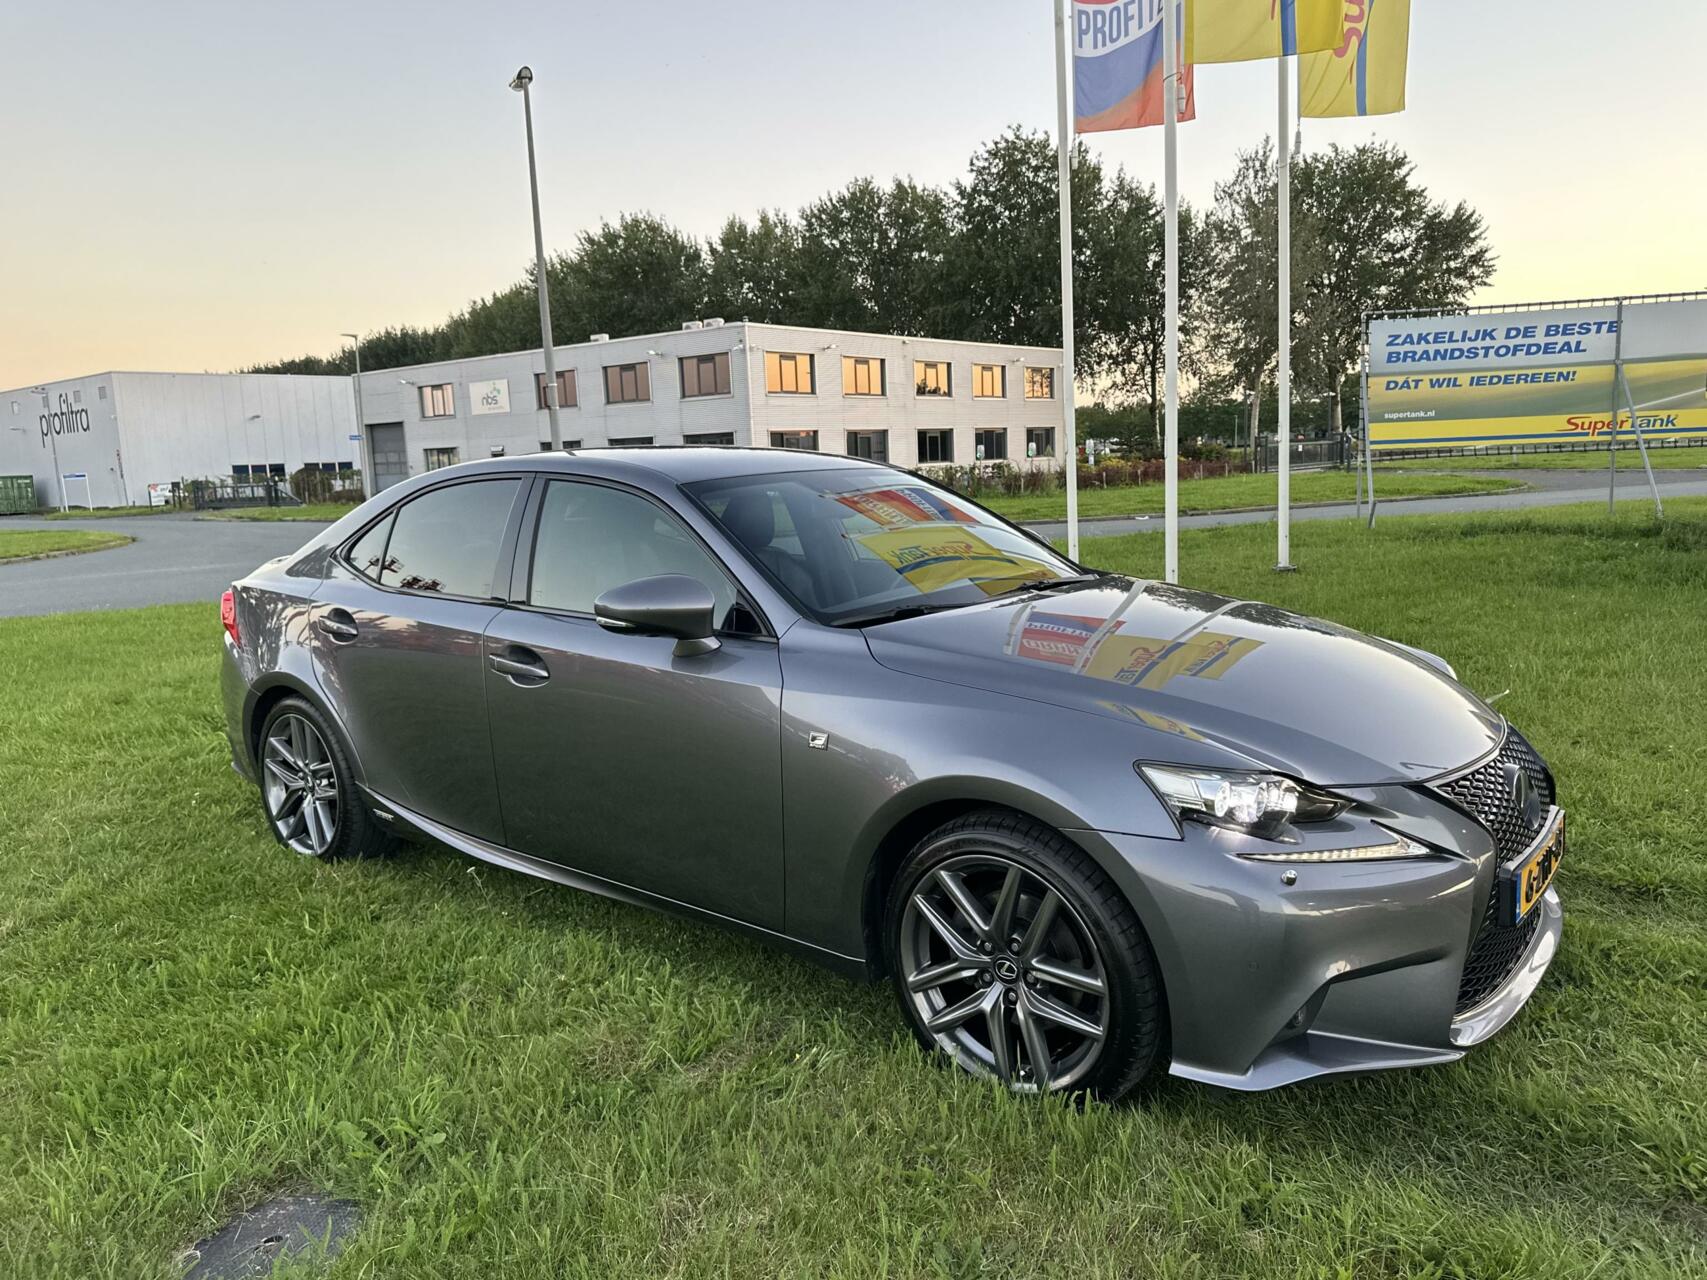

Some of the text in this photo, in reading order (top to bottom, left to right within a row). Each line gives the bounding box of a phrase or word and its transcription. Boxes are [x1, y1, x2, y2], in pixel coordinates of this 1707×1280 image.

[1386, 321, 1619, 346] ZAKELIJK DE BESTE
[1386, 341, 1587, 363] BRANDSTOFDEAL
[1385, 371, 1577, 390] DÁT WIL IEDEREEN!
[1384, 410, 1435, 419] supertank.nl
